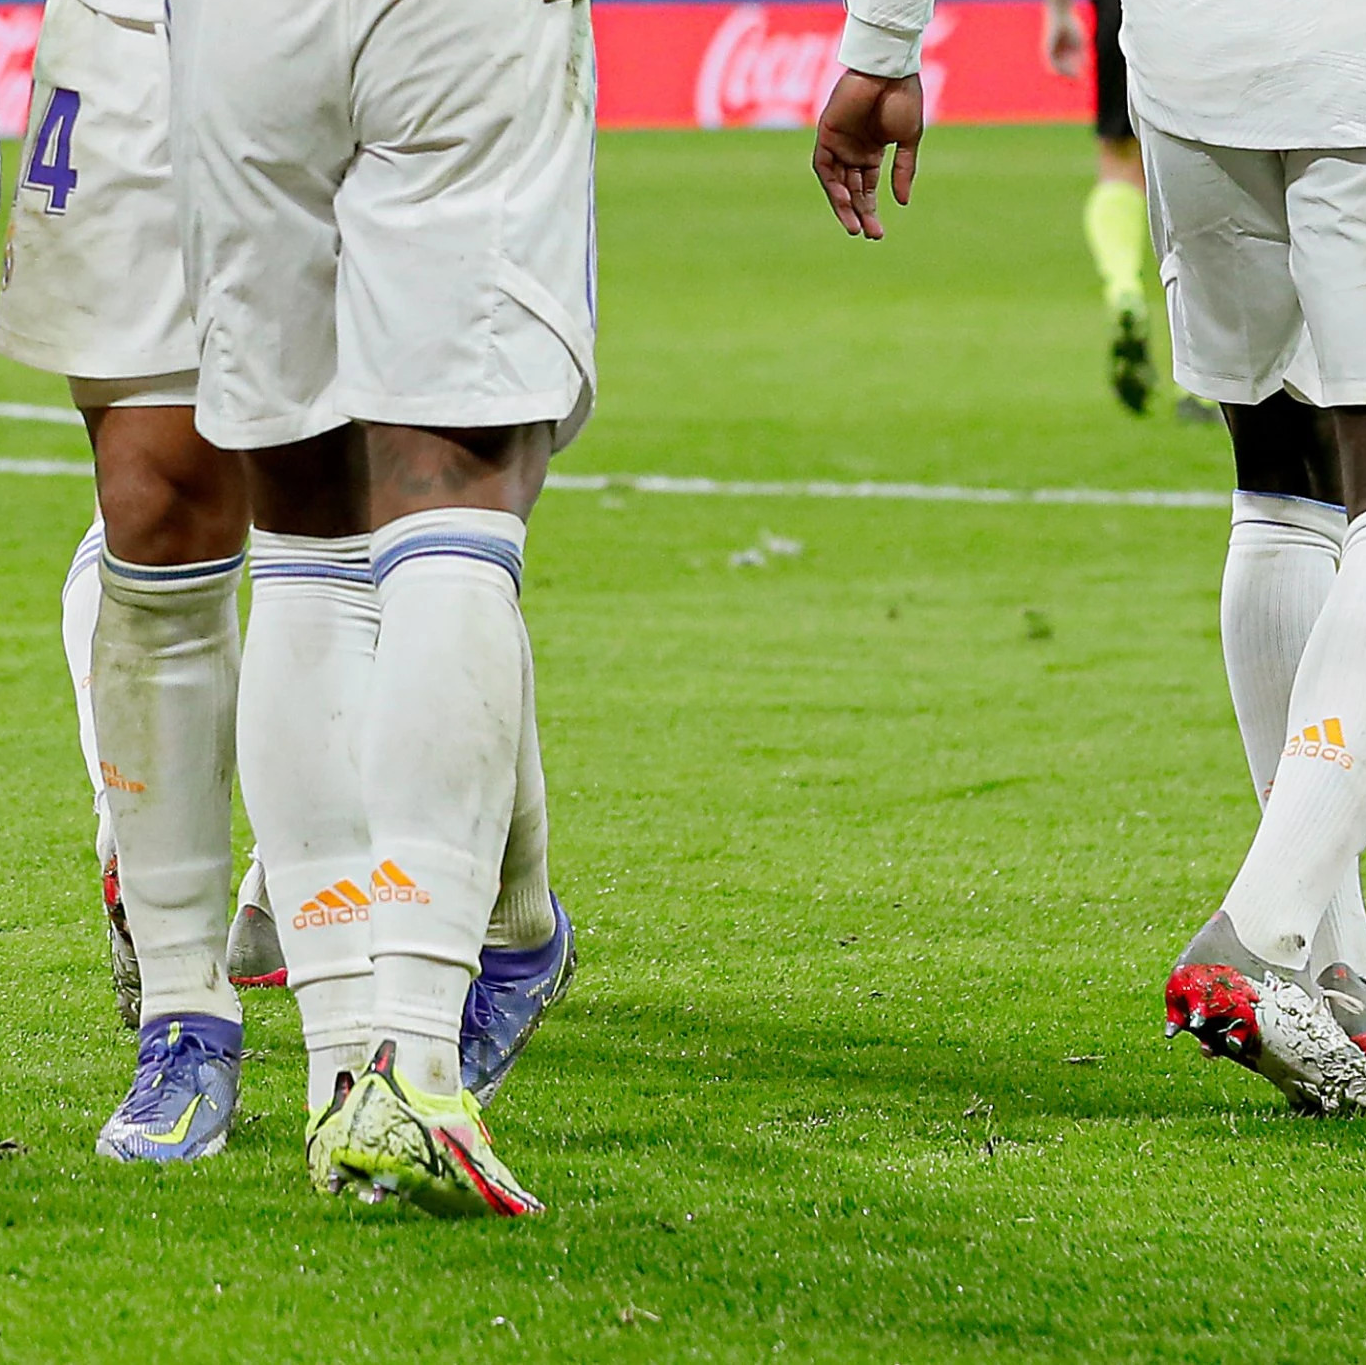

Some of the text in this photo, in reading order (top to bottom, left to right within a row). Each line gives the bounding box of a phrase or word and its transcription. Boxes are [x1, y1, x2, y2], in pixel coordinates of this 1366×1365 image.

[21, 87, 81, 215] 4
[1282, 739, 1354, 770] didas
[369, 880, 432, 905] idas
[292, 905, 370, 931] adida
